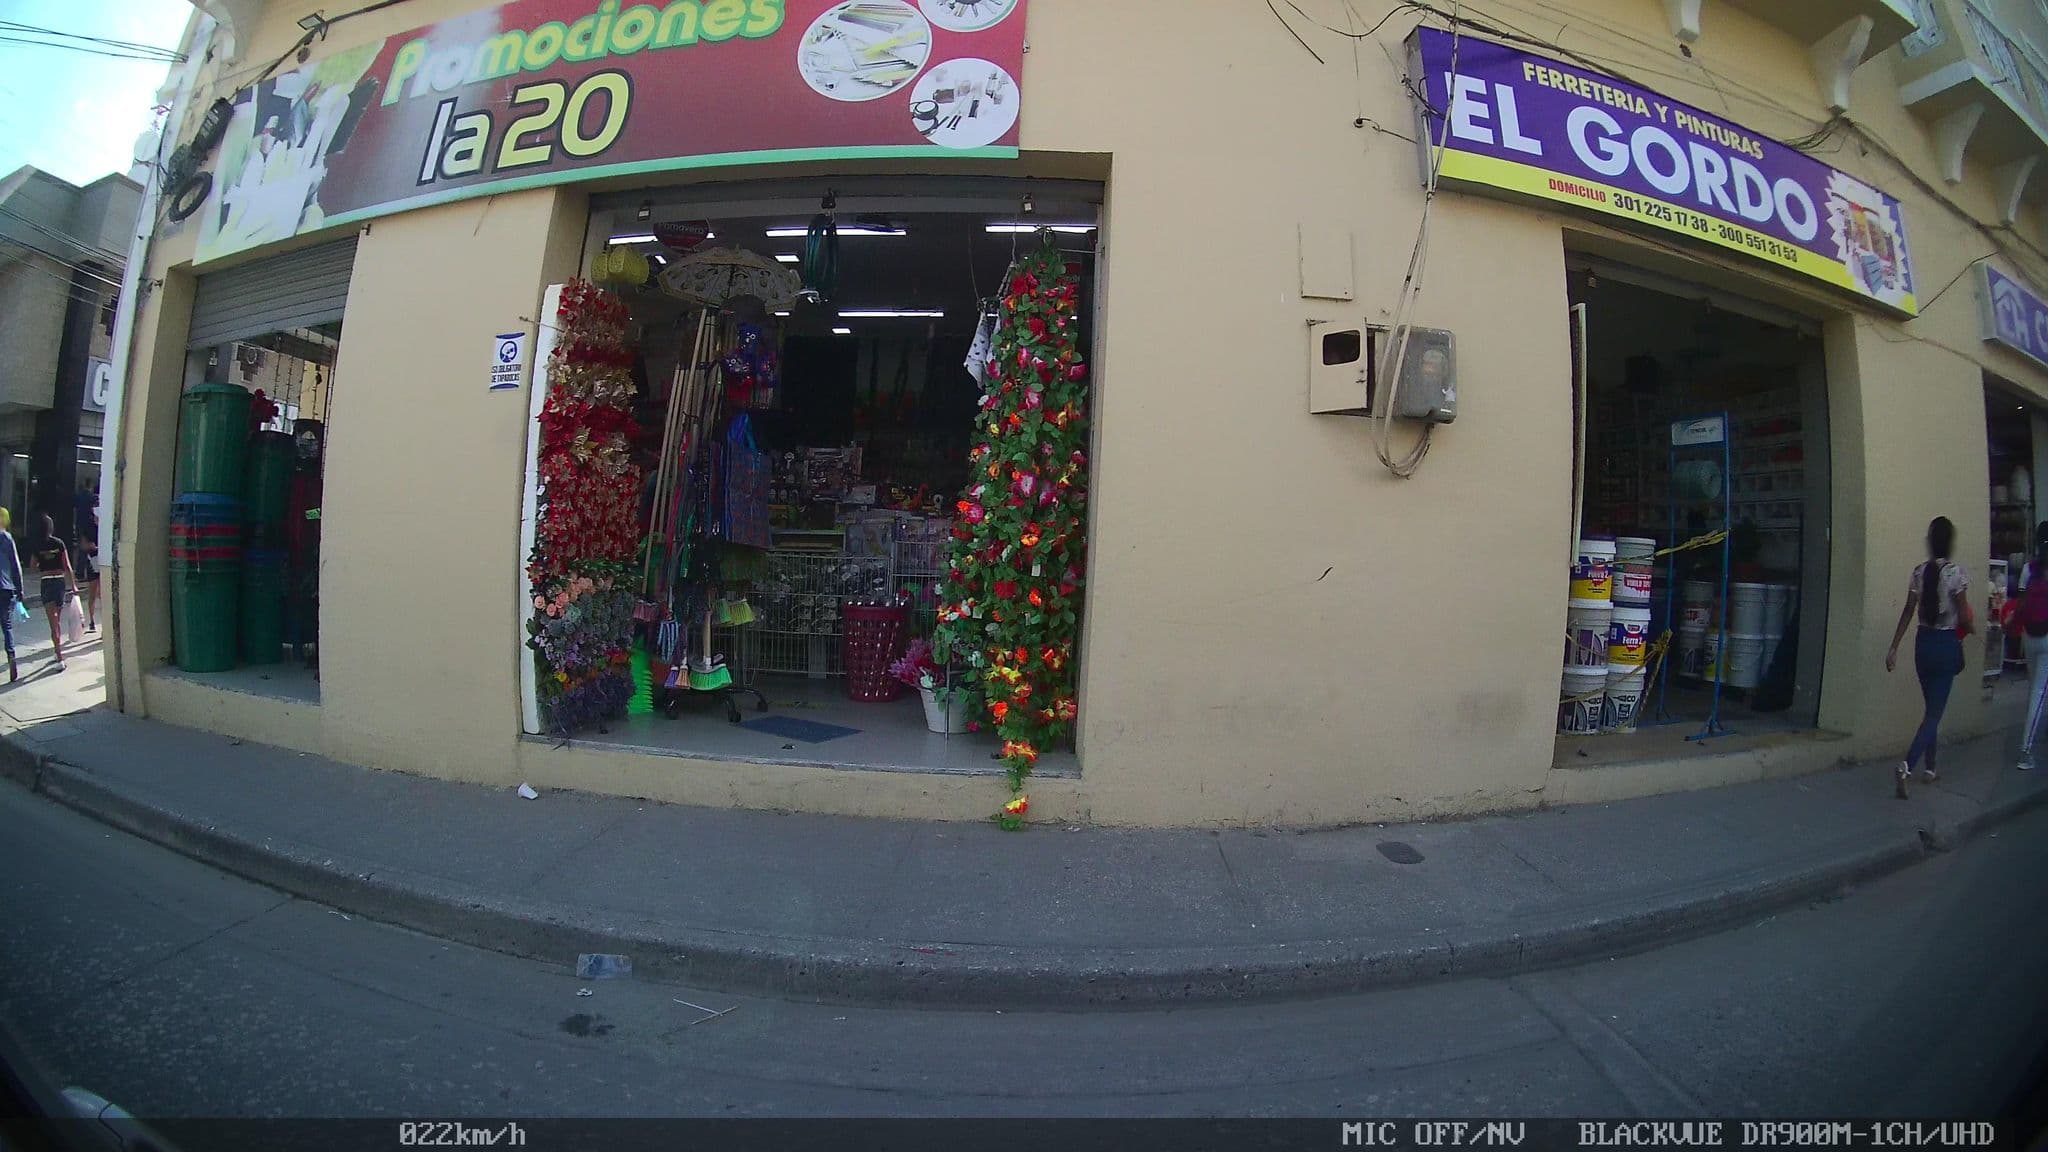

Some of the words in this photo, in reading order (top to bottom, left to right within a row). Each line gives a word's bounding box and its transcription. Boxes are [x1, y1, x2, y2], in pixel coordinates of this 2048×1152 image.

[381, 0, 785, 107] Promociones
[417, 97, 493, 185] la
[494, 69, 633, 173] 20
[1444, 71, 1543, 156] EL
[1566, 105, 1818, 241] GORDO
[1522, 61, 1652, 118] FERRETERIA
[1653, 101, 1668, 123] Y
[1674, 110, 1764, 160] PINTURAS
[1548, 178, 1607, 203] DOMICILIO
[1613, 192, 1642, 213] 301
[1643, 201, 1672, 222] 225
[1718, 224, 1744, 244] 300
